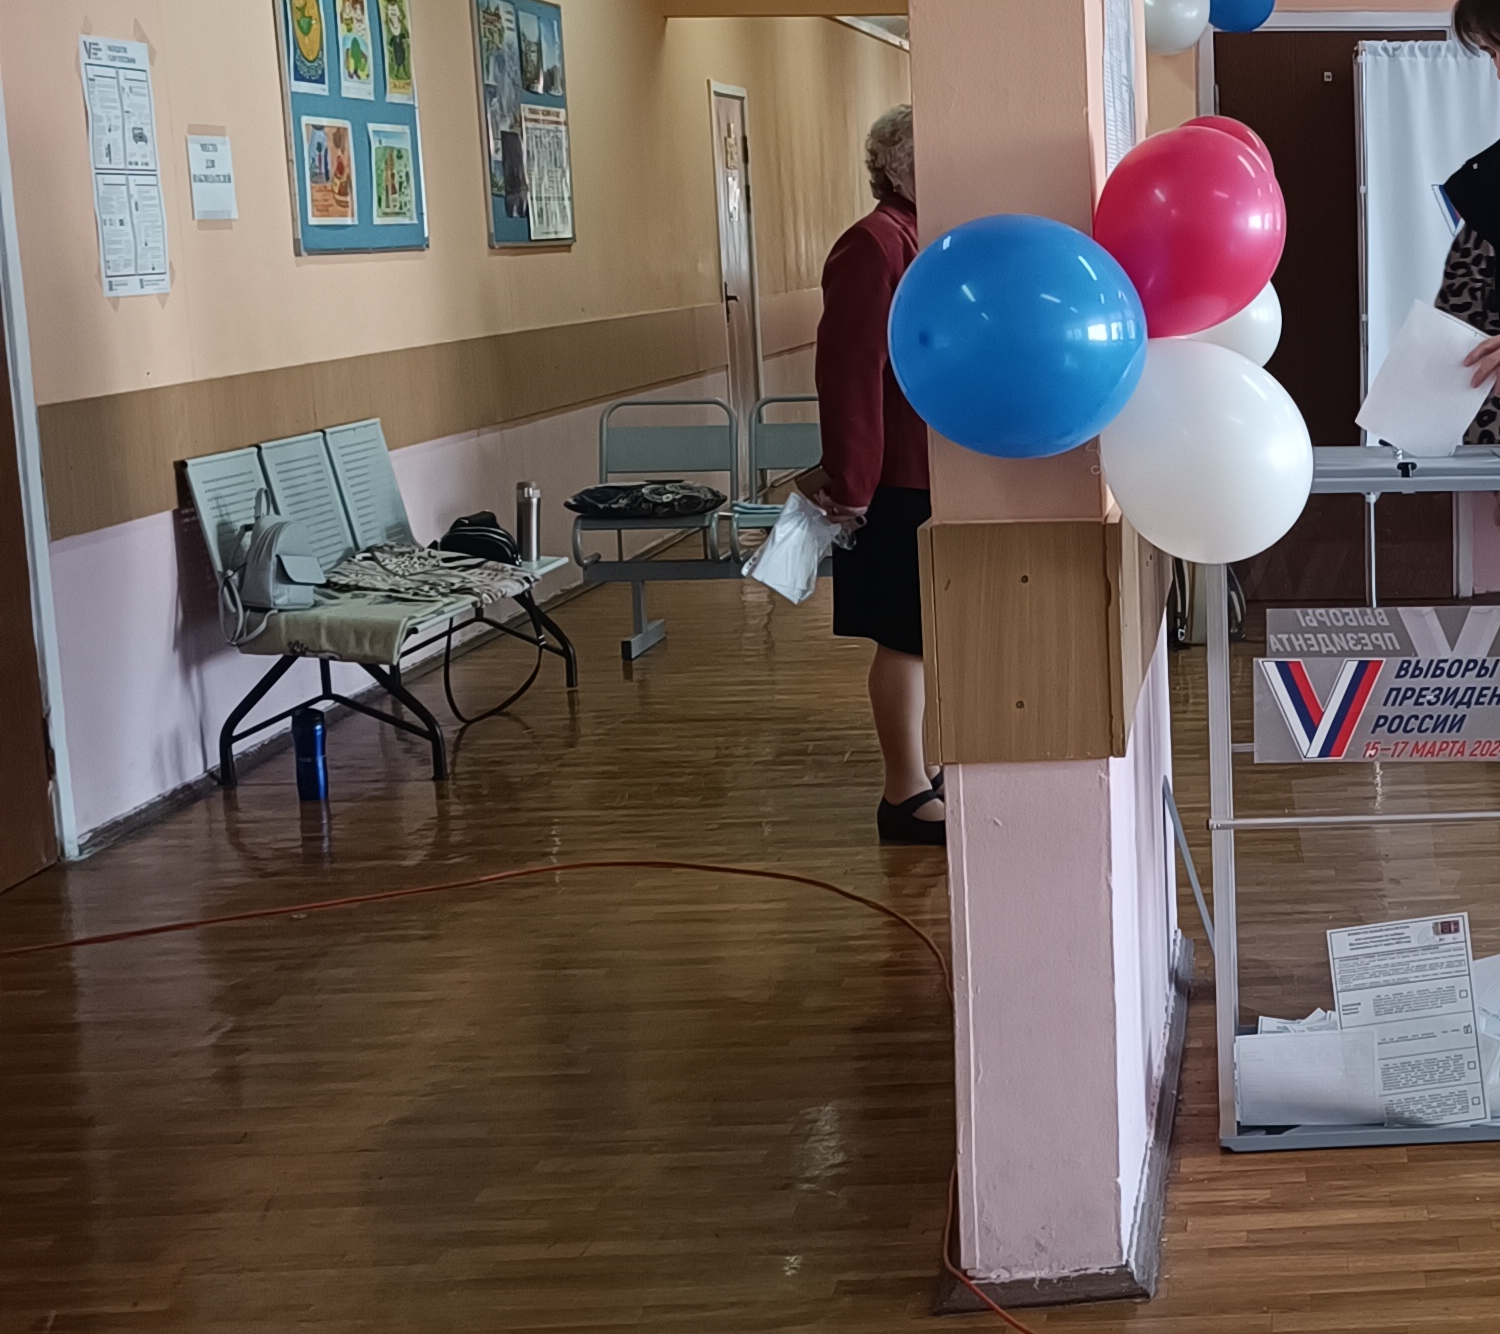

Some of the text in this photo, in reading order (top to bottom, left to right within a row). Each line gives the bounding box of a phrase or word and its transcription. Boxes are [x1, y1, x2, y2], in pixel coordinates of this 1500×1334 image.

[1394, 658, 1500, 680] ВЫБОРЫ
[1370, 713, 1467, 734] РОССИИ
[1410, 740, 1467, 757] МАРТА
